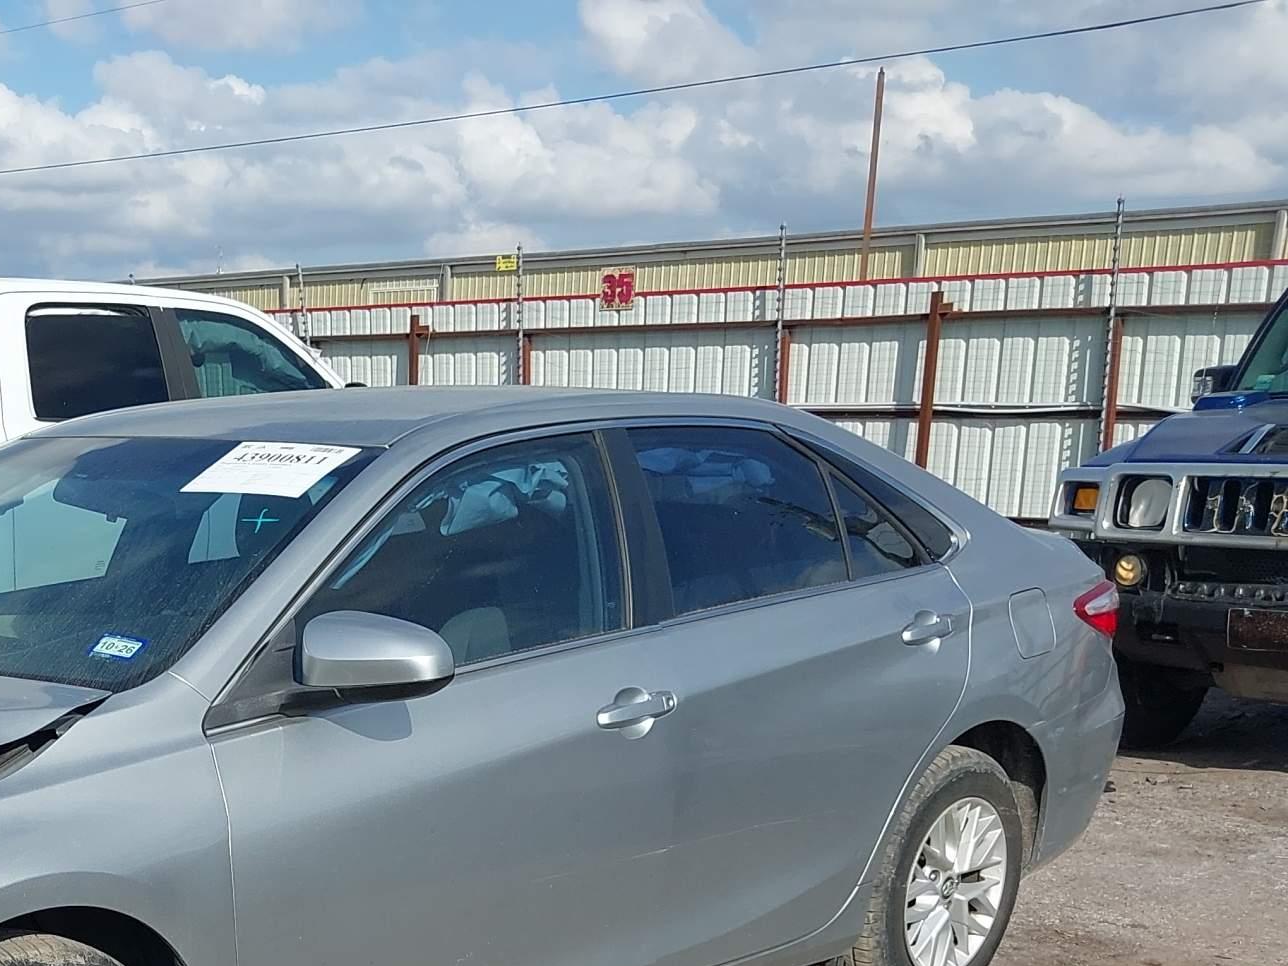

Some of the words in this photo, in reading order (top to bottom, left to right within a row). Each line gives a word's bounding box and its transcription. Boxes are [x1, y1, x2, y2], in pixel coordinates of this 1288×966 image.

[601, 273, 634, 305] 35
[233, 452, 329, 465] 43900811
[100, 641, 115, 651] 10
[118, 644, 136, 655] 26
